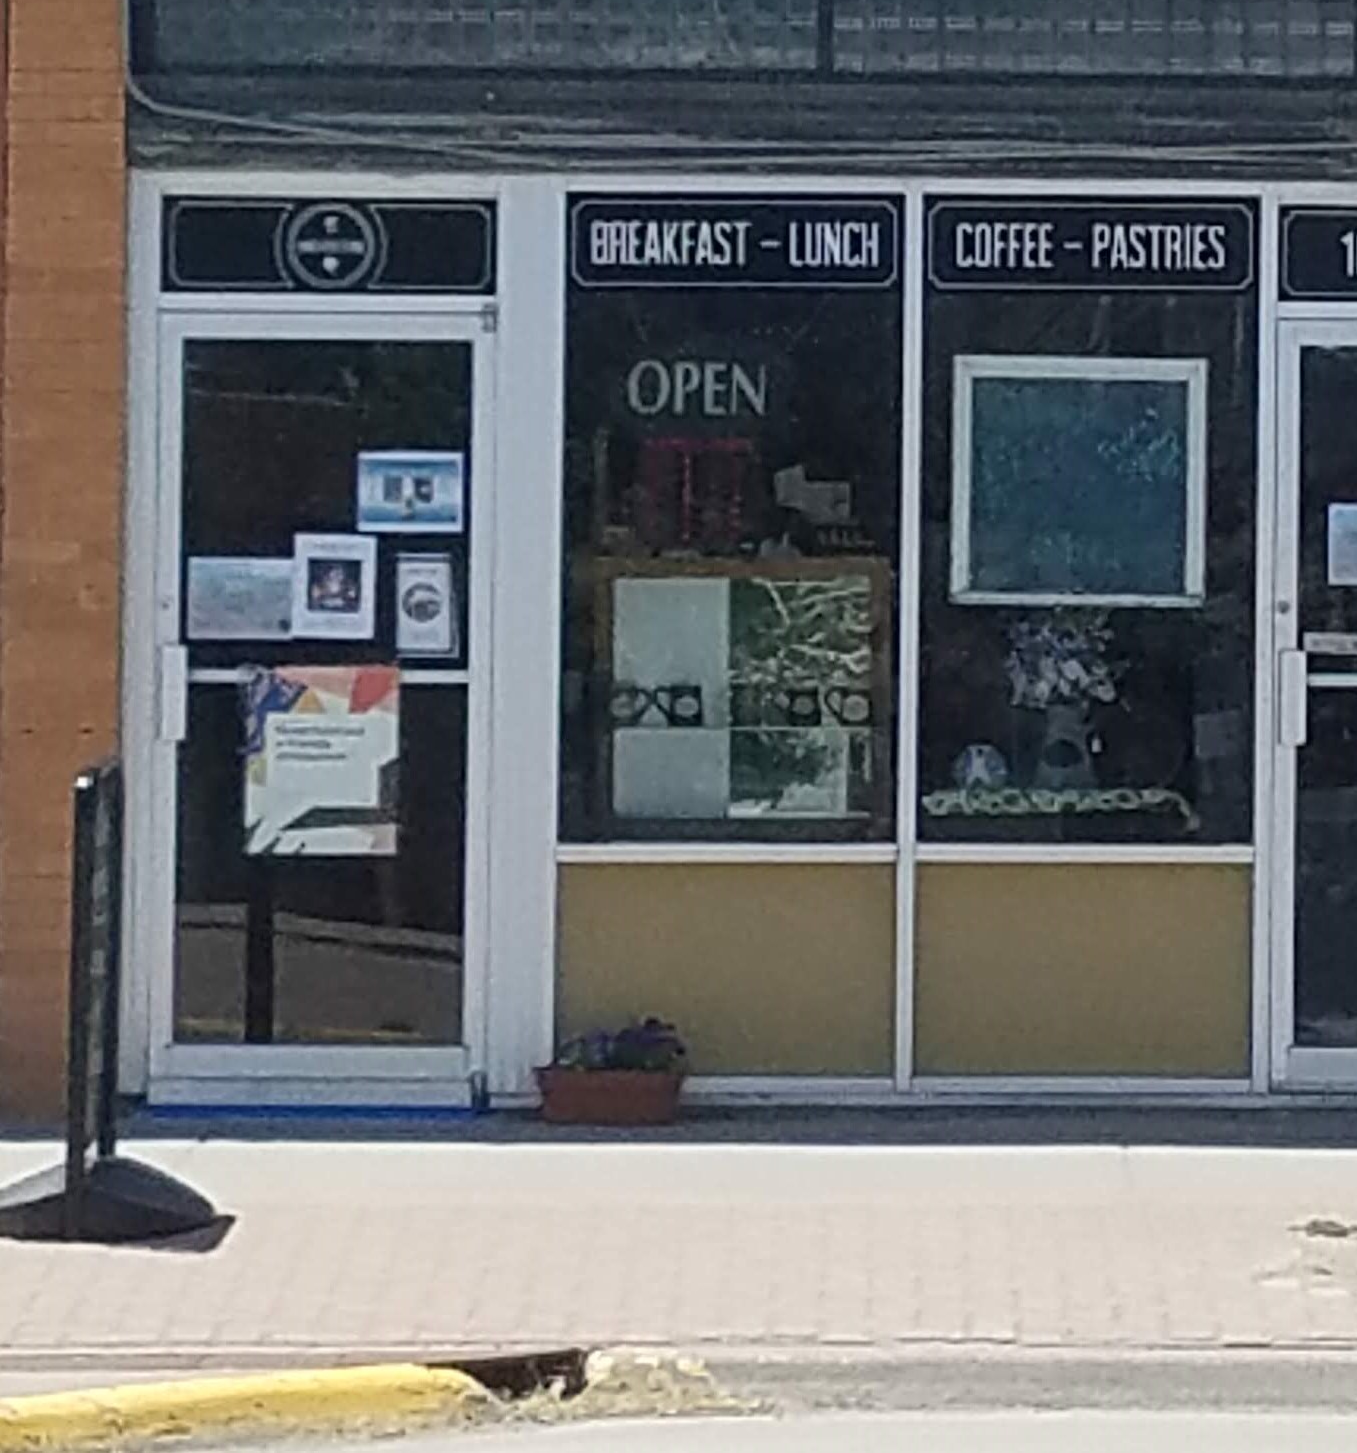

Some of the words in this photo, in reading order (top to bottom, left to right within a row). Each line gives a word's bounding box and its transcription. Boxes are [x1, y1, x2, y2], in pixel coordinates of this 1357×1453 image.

[590, 219, 752, 266] BREAKFAST
[789, 220, 880, 268] LUNCH
[955, 222, 1055, 268] COFFEE
[1091, 222, 1226, 271] PASTRIES
[627, 359, 767, 416] OPEN
